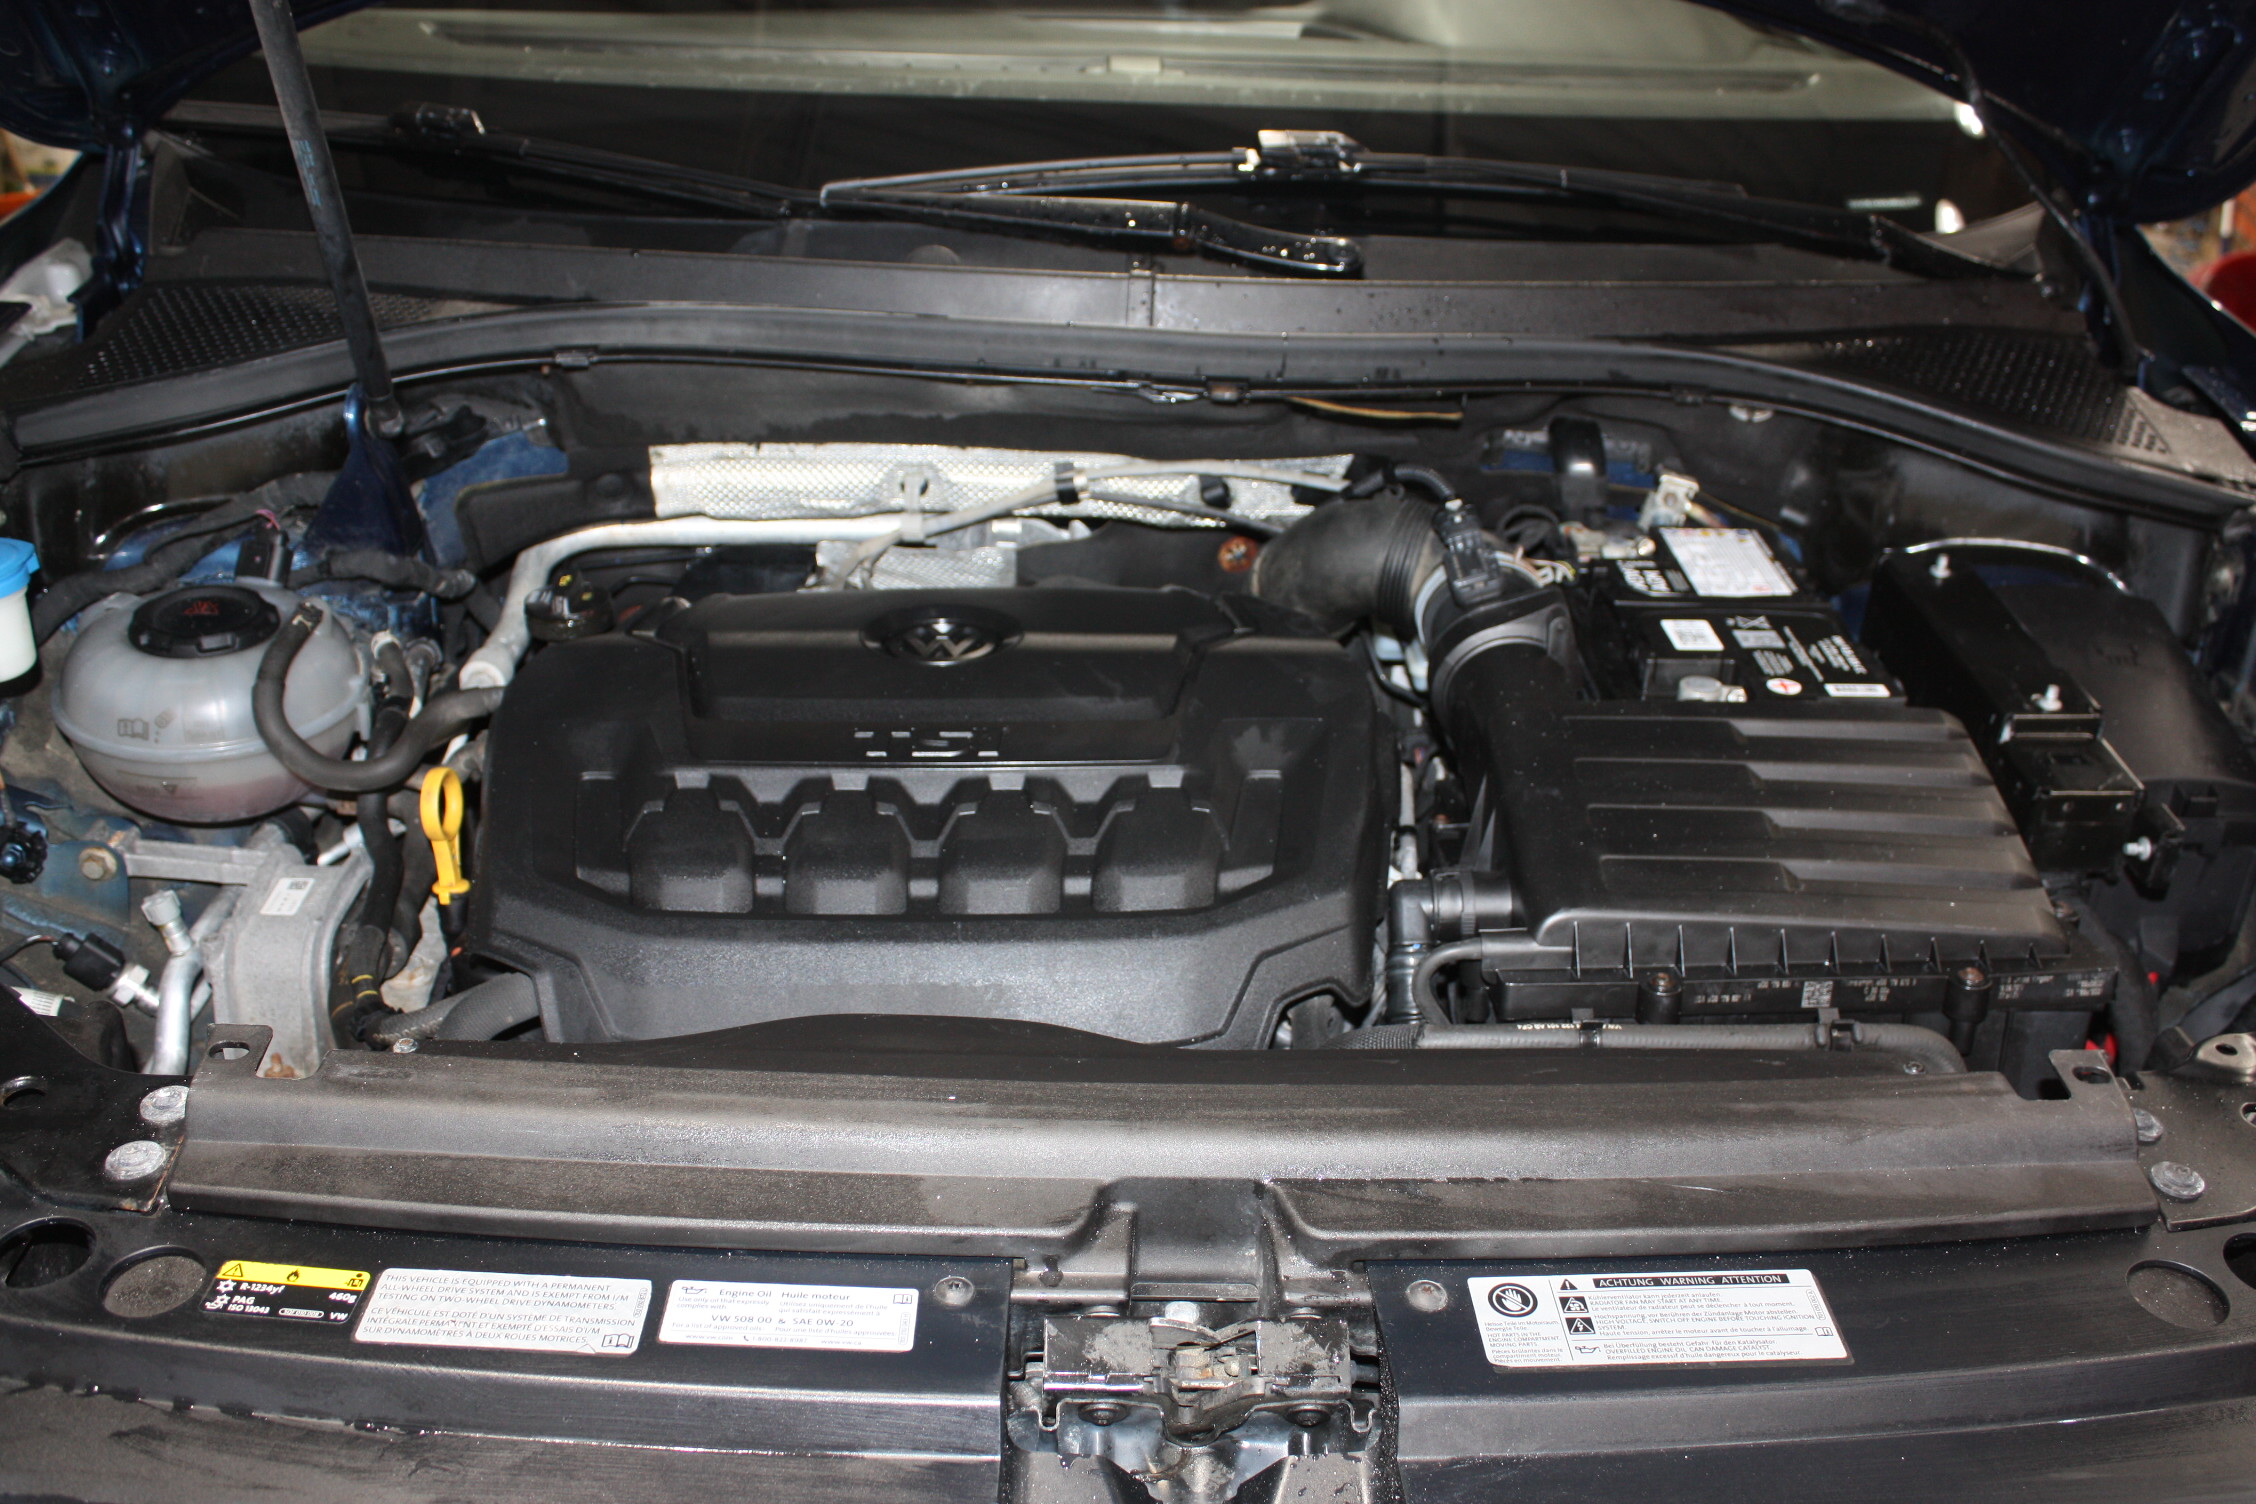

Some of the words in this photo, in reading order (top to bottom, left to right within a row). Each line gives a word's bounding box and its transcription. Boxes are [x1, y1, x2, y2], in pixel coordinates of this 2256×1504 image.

[384, 1274, 408, 1282] THIS
[408, 1275, 449, 1283] VEHICLE
[460, 1278, 511, 1287] EQUIPPED
[550, 1282, 611, 1291] PERMANENT
[1597, 1278, 1654, 1286] ACHTUNG
[1659, 1276, 1715, 1285] WARNING
[1720, 1275, 1781, 1283] ATTENTION
[239, 1282, 285, 1294] R-1234yf
[380, 1283, 436, 1292] ALL-WHEEL
[467, 1287, 505, 1295] SYSTEM
[542, 1290, 579, 1299] EXEMPT
[582, 1292, 610, 1300] FROM
[612, 1293, 629, 1301] I/M
[718, 1289, 755, 1298] Engine
[231, 1295, 255, 1304] PAG
[328, 1291, 358, 1303] 460g
[377, 1292, 418, 1300] TESTING
[437, 1295, 500, 1304] TWO-WHEEL
[501, 1298, 533, 1306] DRIVE
[533, 1299, 617, 1310] DYNAMOMETERS.
[781, 1291, 809, 1299] Huile
[811, 1292, 850, 1300] moteur
[227, 1304, 244, 1312] ISO
[244, 1305, 270, 1314] 13043
[329, 1311, 349, 1320] VW
[383, 1306, 432, 1316] VÉHICULE
[450, 1309, 478, 1318] DOTÉ
[506, 1312, 547, 1322] SYSTÈME
[564, 1316, 635, 1326] TRANSMISSION
[366, 1315, 419, 1325] INTÉGRALE
[490, 1320, 532, 1330] EXEMPTÉ
[533, 1324, 574, 1332] D'ESSAIS
[816, 1318, 853, 1326] 0W-20
[383, 1325, 464, 1337] DYNAMOMÈTRES
[465, 1329, 473, 1337] À
[474, 1331, 502, 1339] DEUX
[504, 1332, 537, 1341] ROUES
